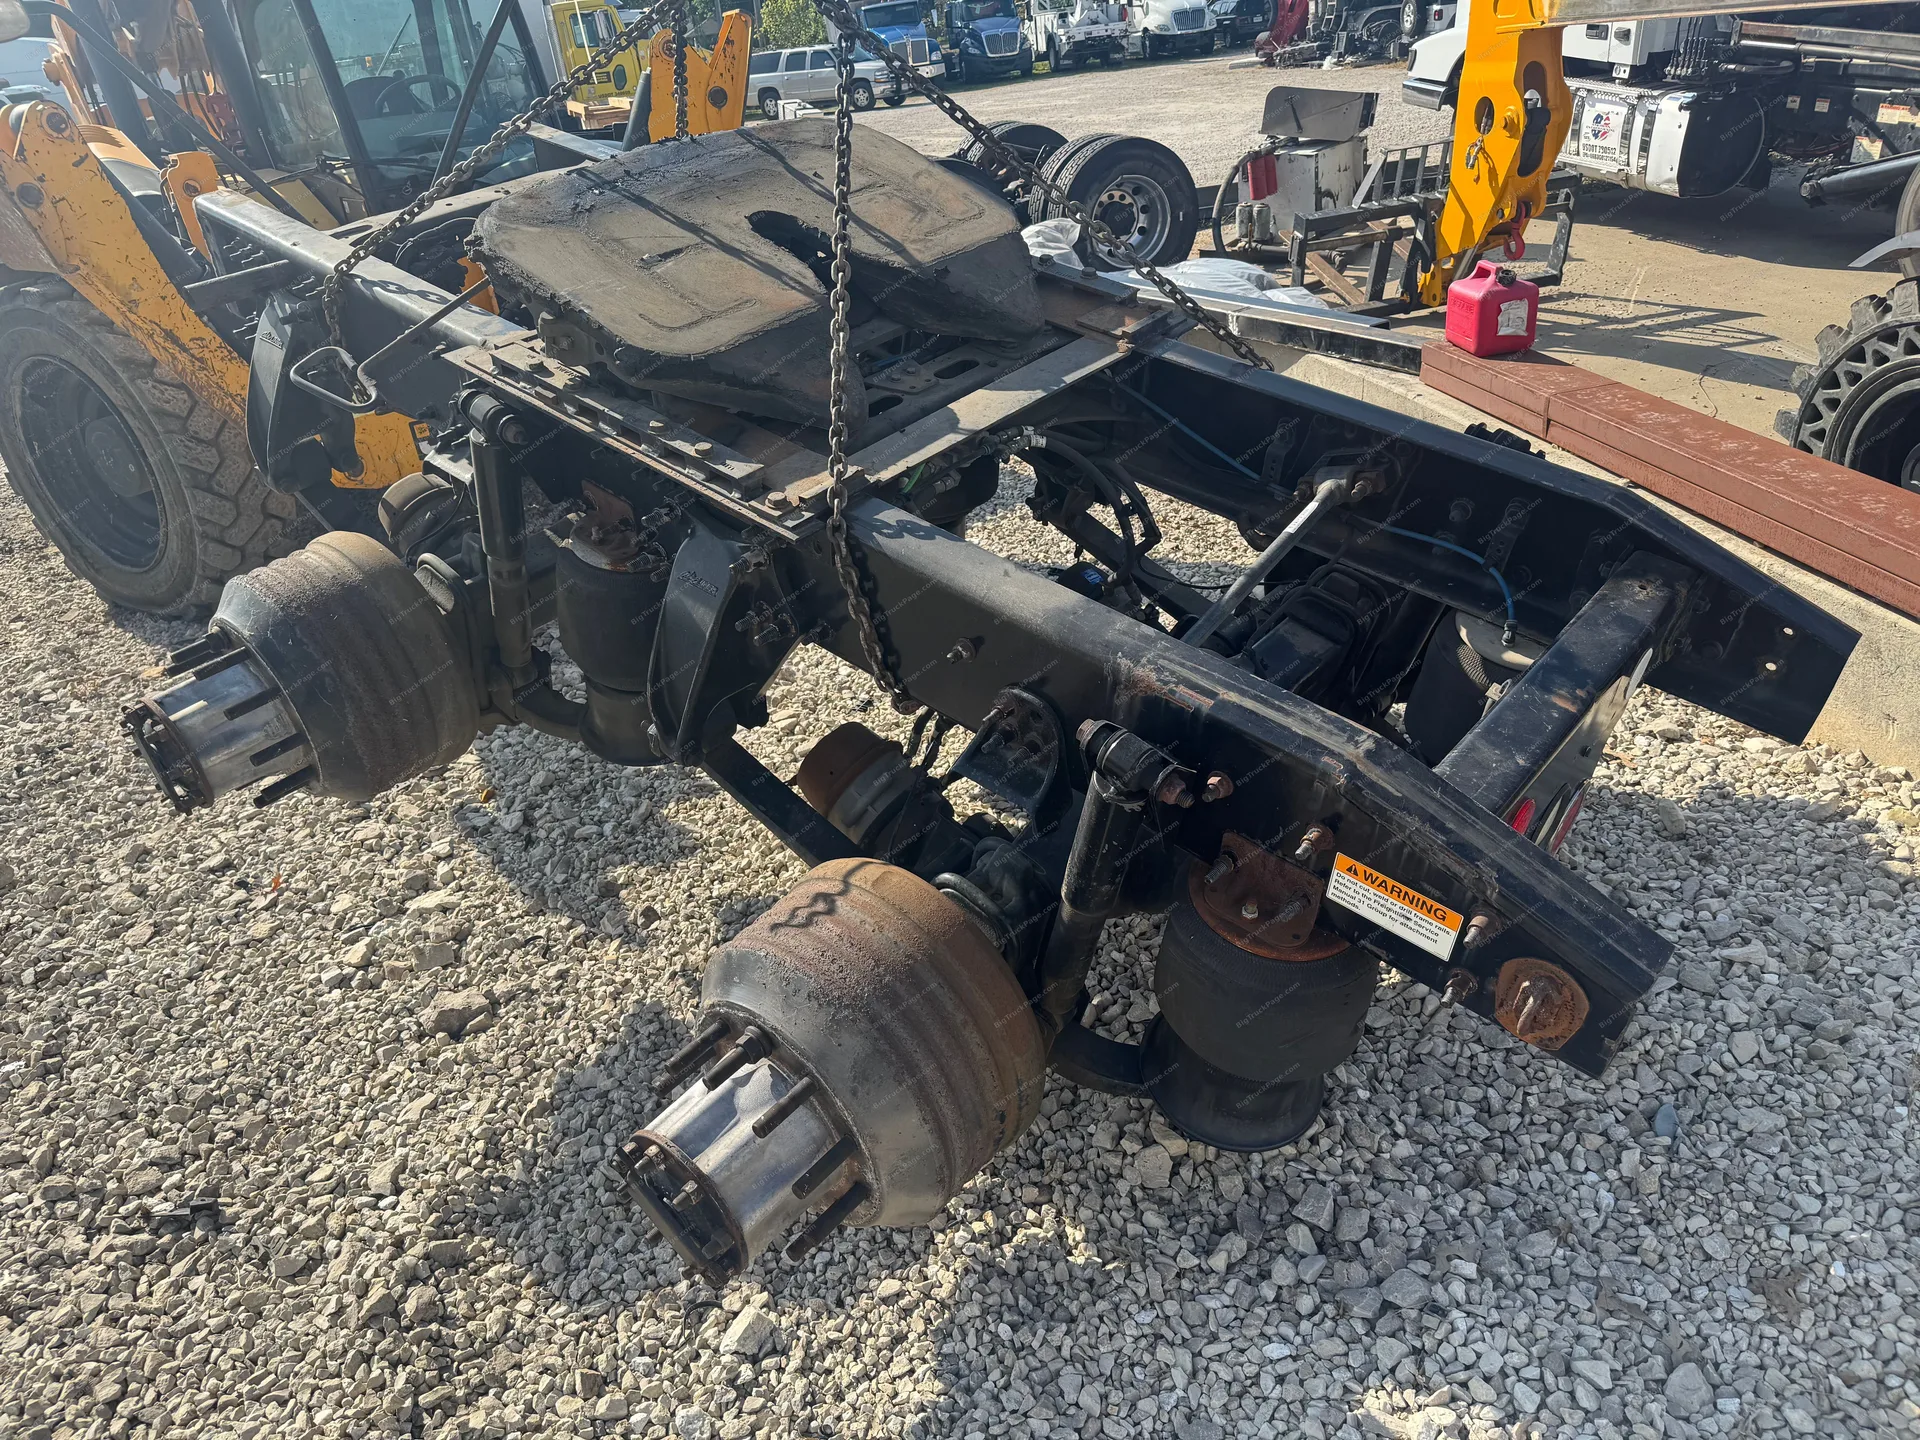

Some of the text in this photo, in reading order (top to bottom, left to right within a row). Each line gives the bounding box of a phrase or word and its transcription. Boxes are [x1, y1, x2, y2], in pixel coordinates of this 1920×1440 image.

[1330, 892, 1361, 911] methods.
[1332, 885, 1357, 901] Manual
[1366, 903, 1388, 917] Group
[1388, 914, 1398, 923] for
[1399, 920, 1438, 945] attachment
[1334, 878, 1352, 891] Refer
[1361, 892, 1373, 902] the
[1413, 919, 1440, 937] Service
[1336, 872, 1346, 880] Do
[1347, 879, 1358, 887] not
[1359, 885, 1371, 894] cut,
[1373, 891, 1389, 903] weld
[1399, 905, 1413, 916] drill
[1413, 912, 1434, 926] frame
[1434, 924, 1451, 936] rails.
[1363, 869, 1447, 922] WARNING
